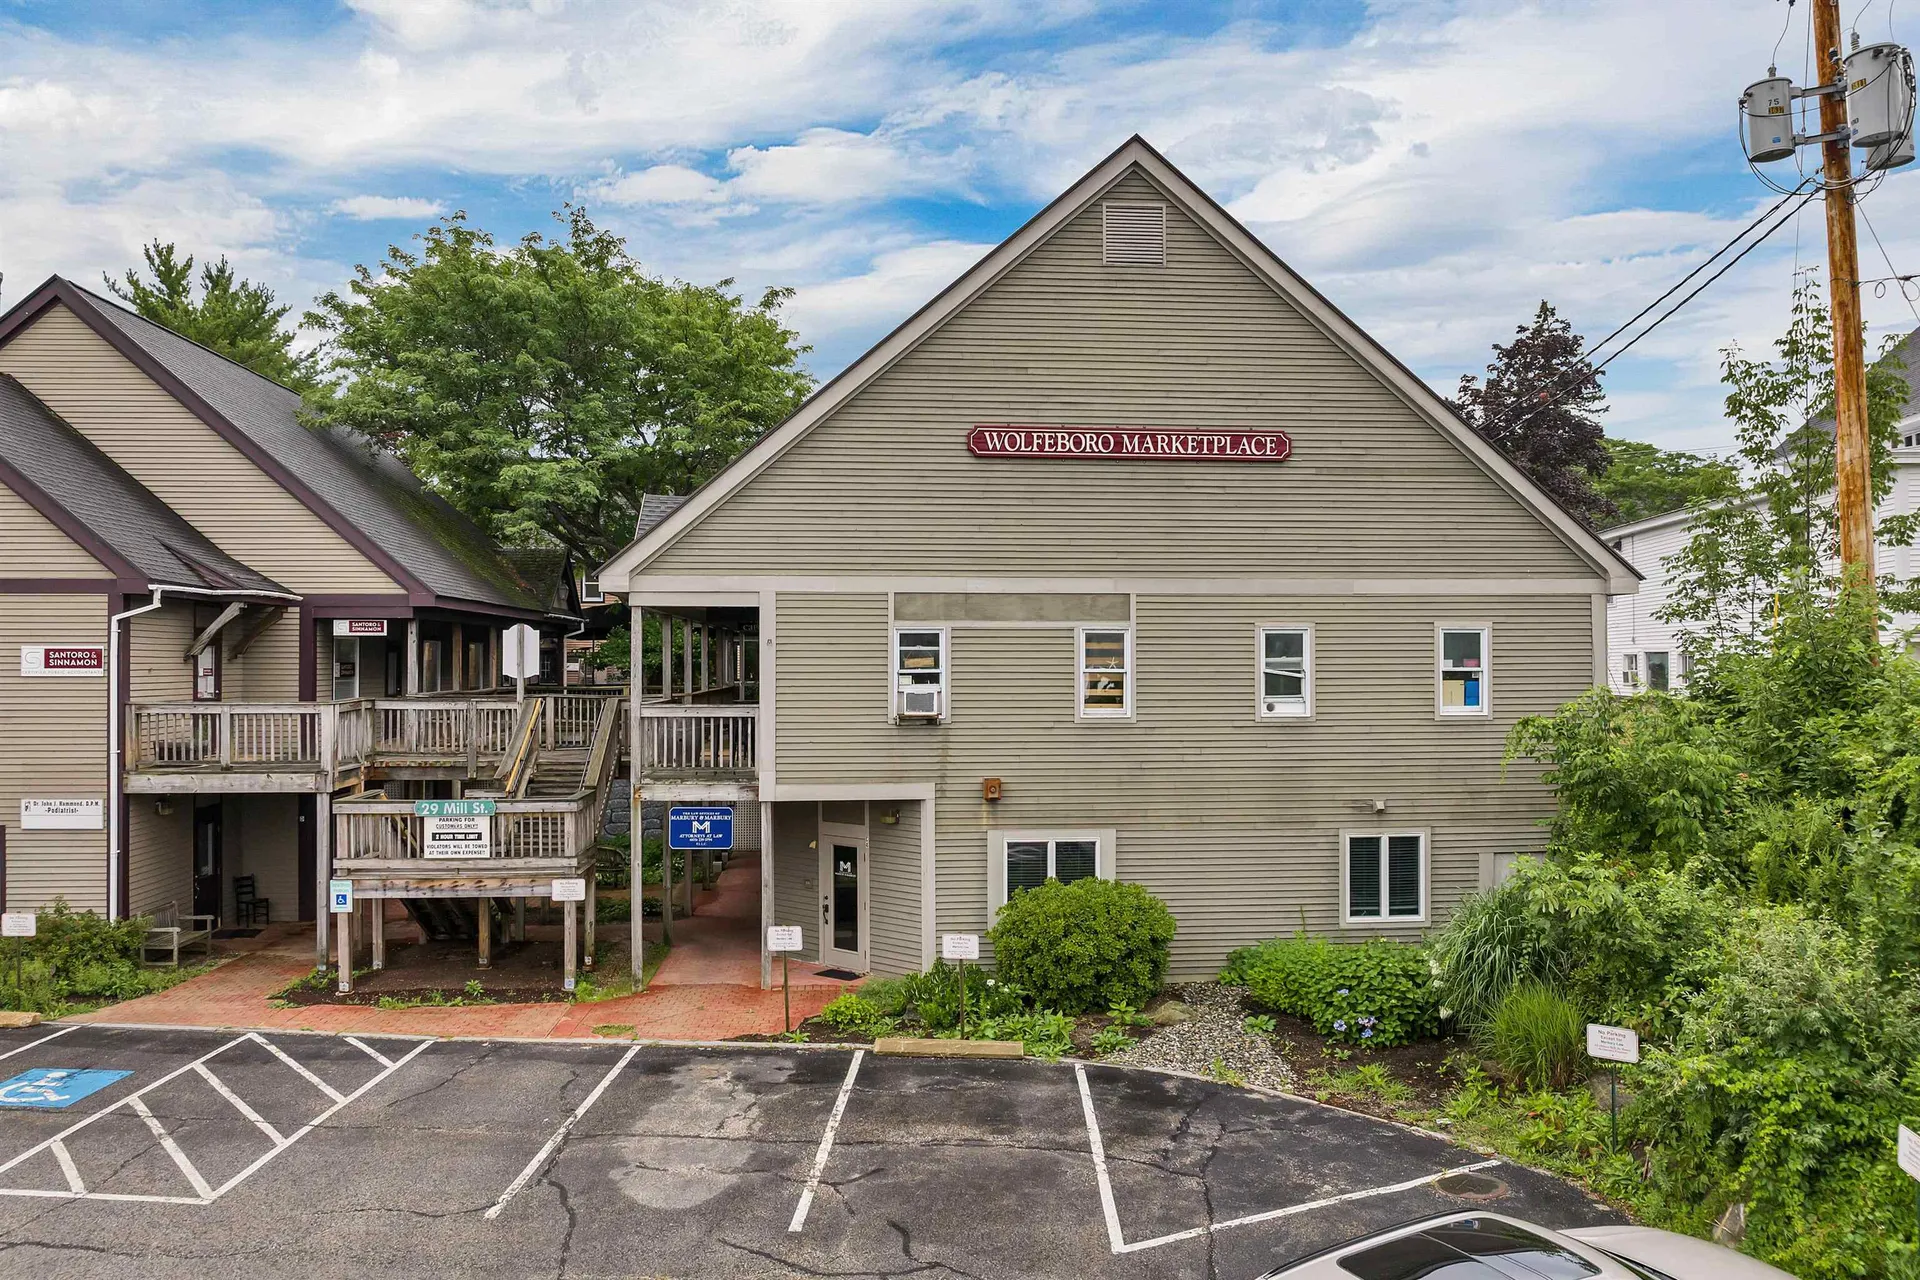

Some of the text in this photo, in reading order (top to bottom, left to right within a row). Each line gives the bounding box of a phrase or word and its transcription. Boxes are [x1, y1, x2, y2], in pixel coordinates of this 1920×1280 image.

[1768, 98, 1780, 106] 75
[983, 431, 1278, 456] WOLFEBORO MARKETPLACE
[49, 651, 97, 659] SANTORO &
[421, 802, 488, 815] 29 Mill St.
[692, 820, 710, 834] M
[840, 860, 851, 873] M
[1606, 1031, 1626, 1039] Parking
